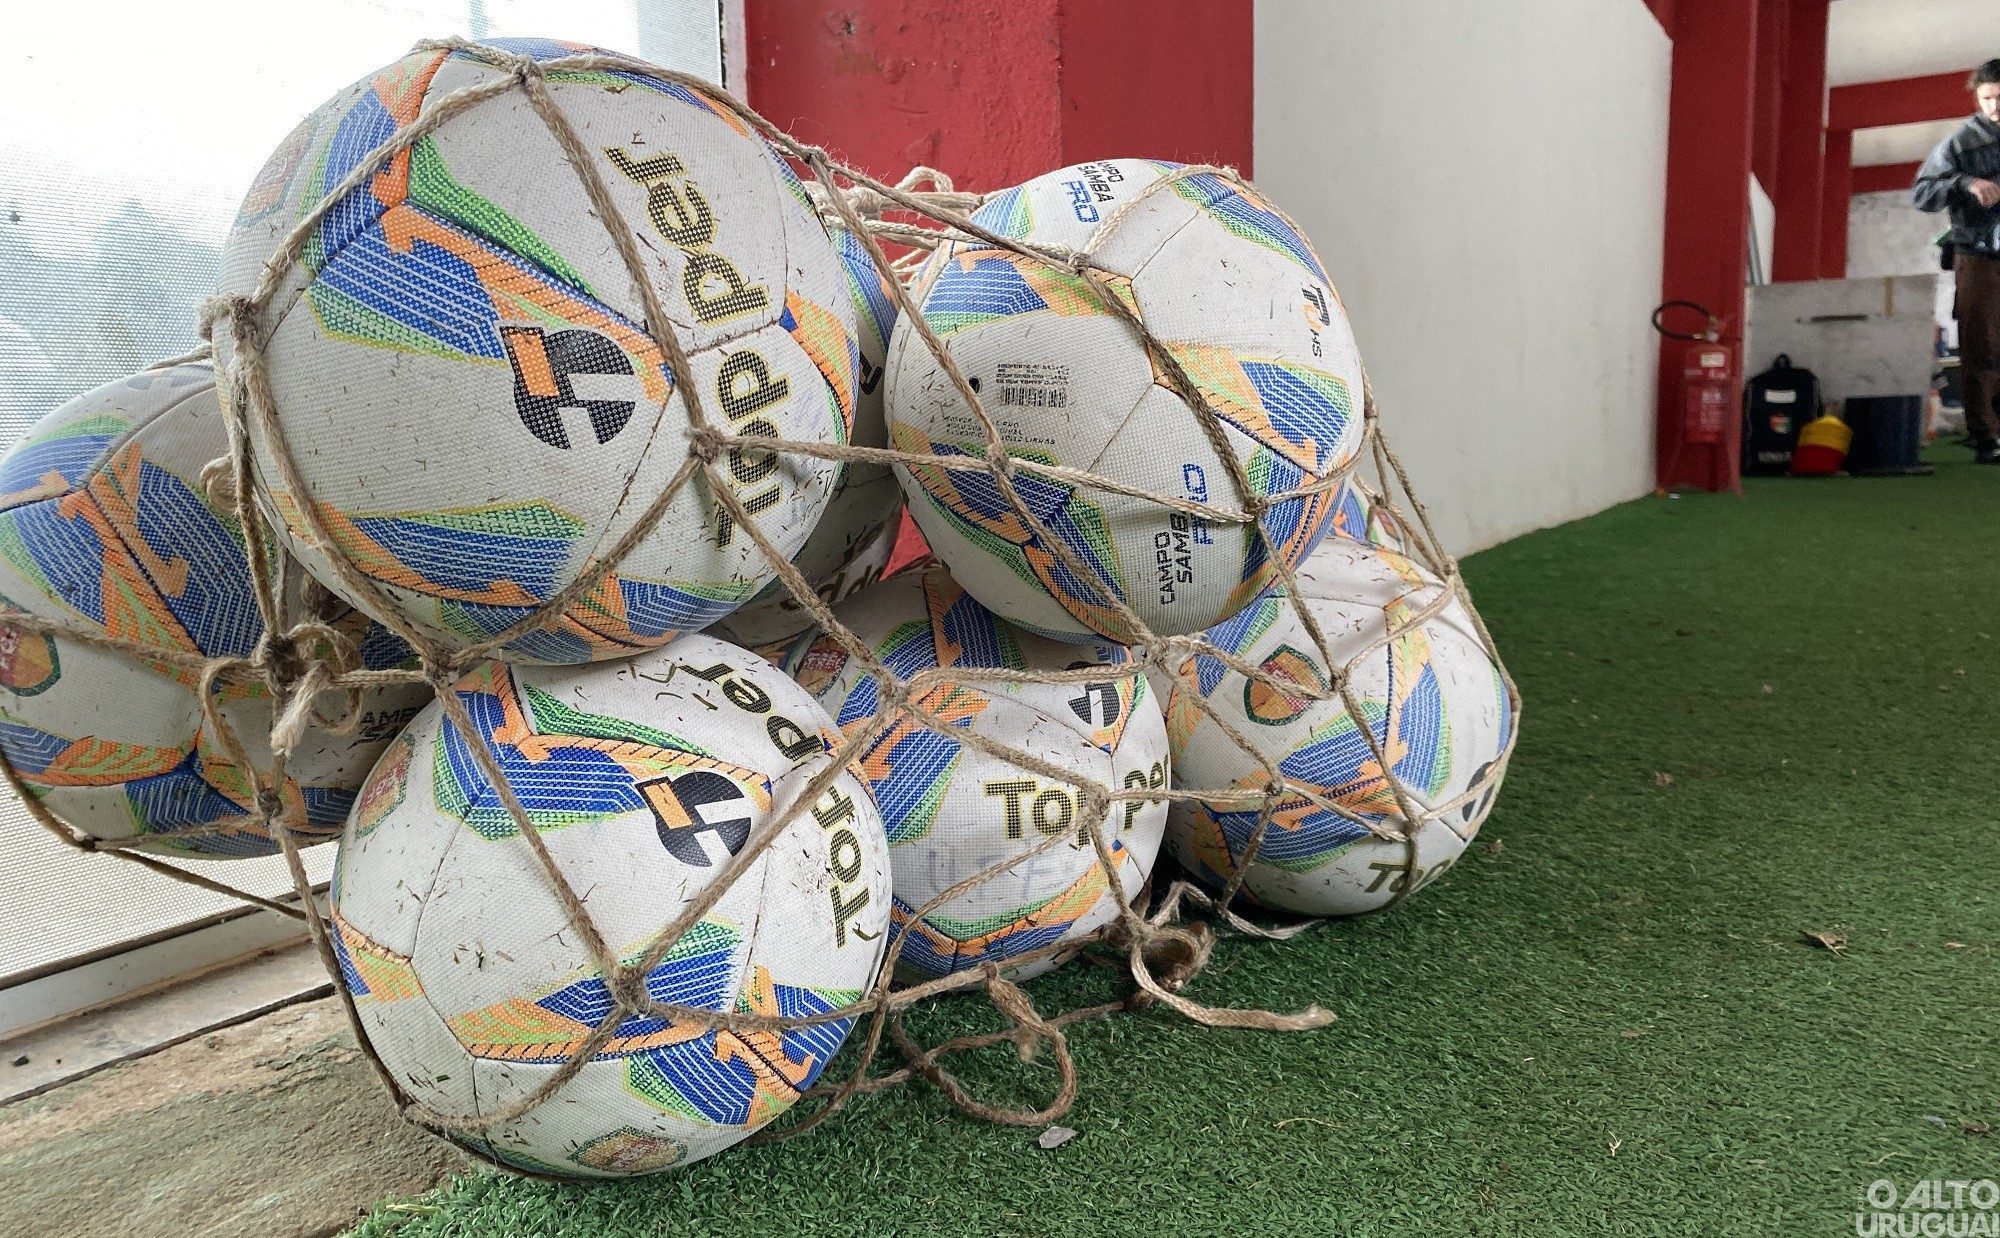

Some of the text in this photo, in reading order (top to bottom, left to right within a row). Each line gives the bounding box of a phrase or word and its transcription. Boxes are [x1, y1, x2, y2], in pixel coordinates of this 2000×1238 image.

[1061, 180, 1099, 222] PRO
[1077, 165, 1114, 202] SAMBA
[1154, 531, 1176, 605] CAMPO
[1170, 496, 1193, 584] SAMB
